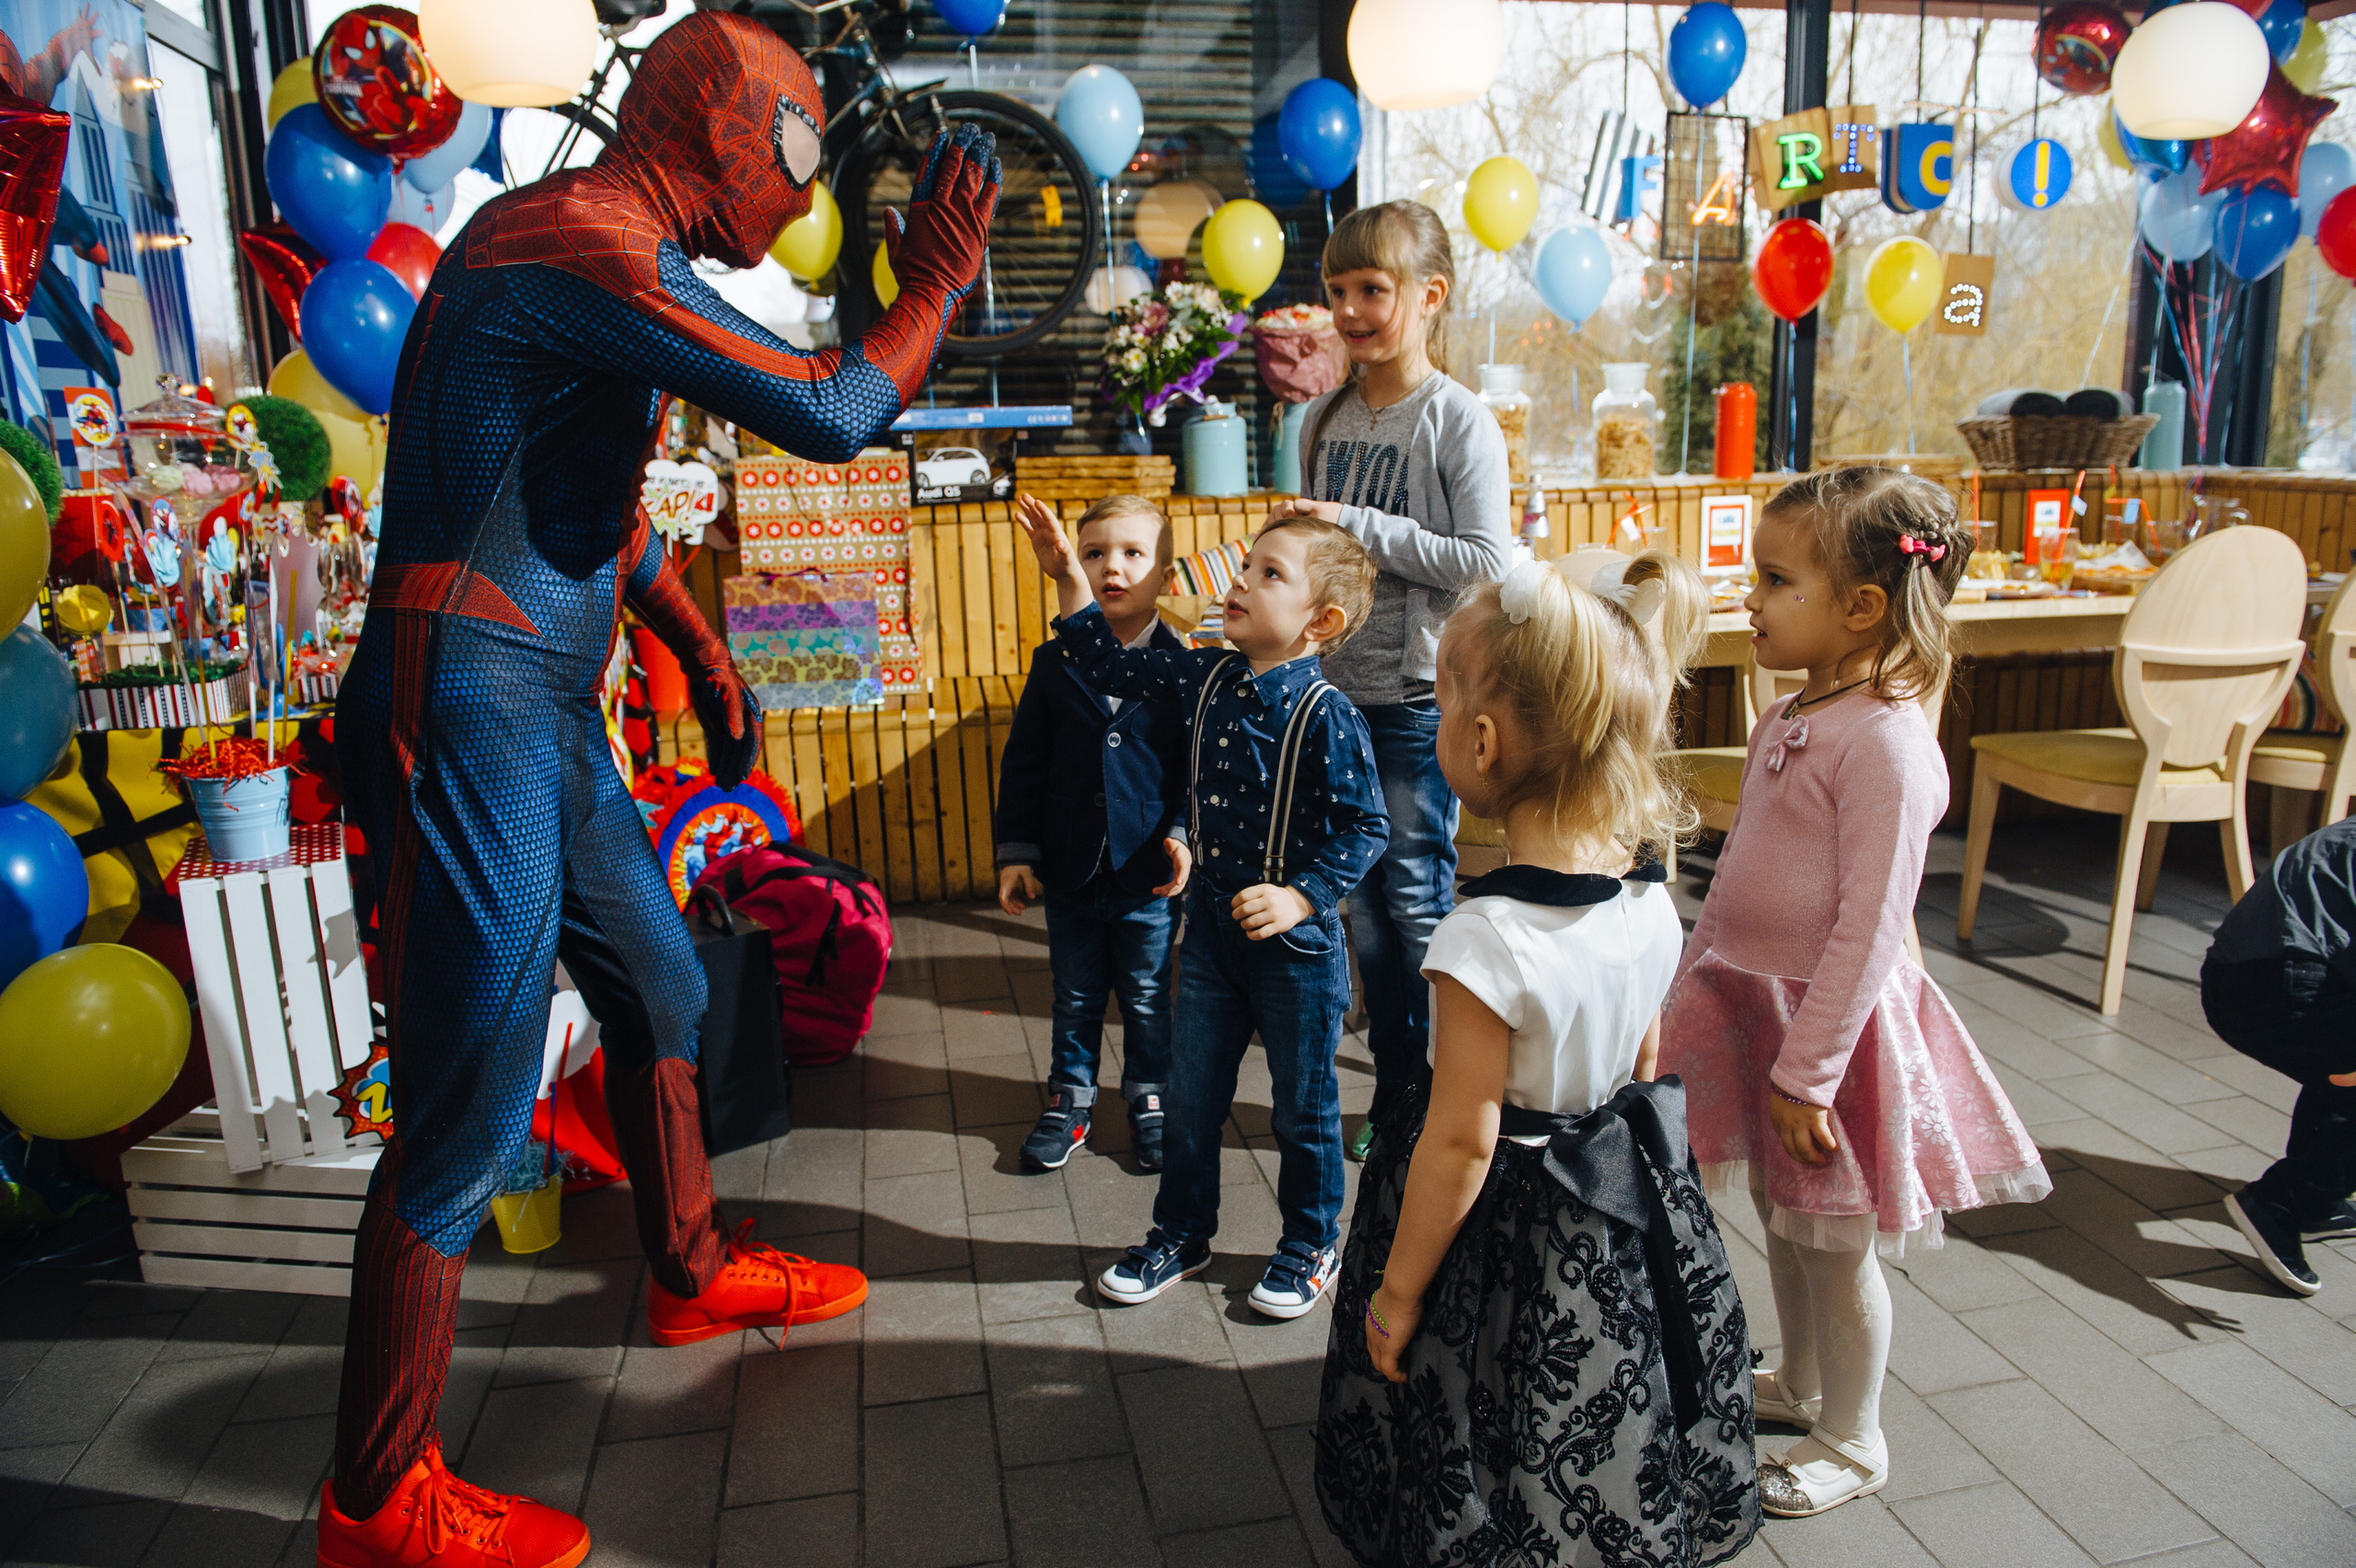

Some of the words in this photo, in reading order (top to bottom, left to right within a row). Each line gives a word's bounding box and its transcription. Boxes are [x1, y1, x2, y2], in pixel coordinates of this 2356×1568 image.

[1944, 283, 1983, 327] a
[917, 487, 942, 500] Audi
[944, 485, 961, 498] Q5
